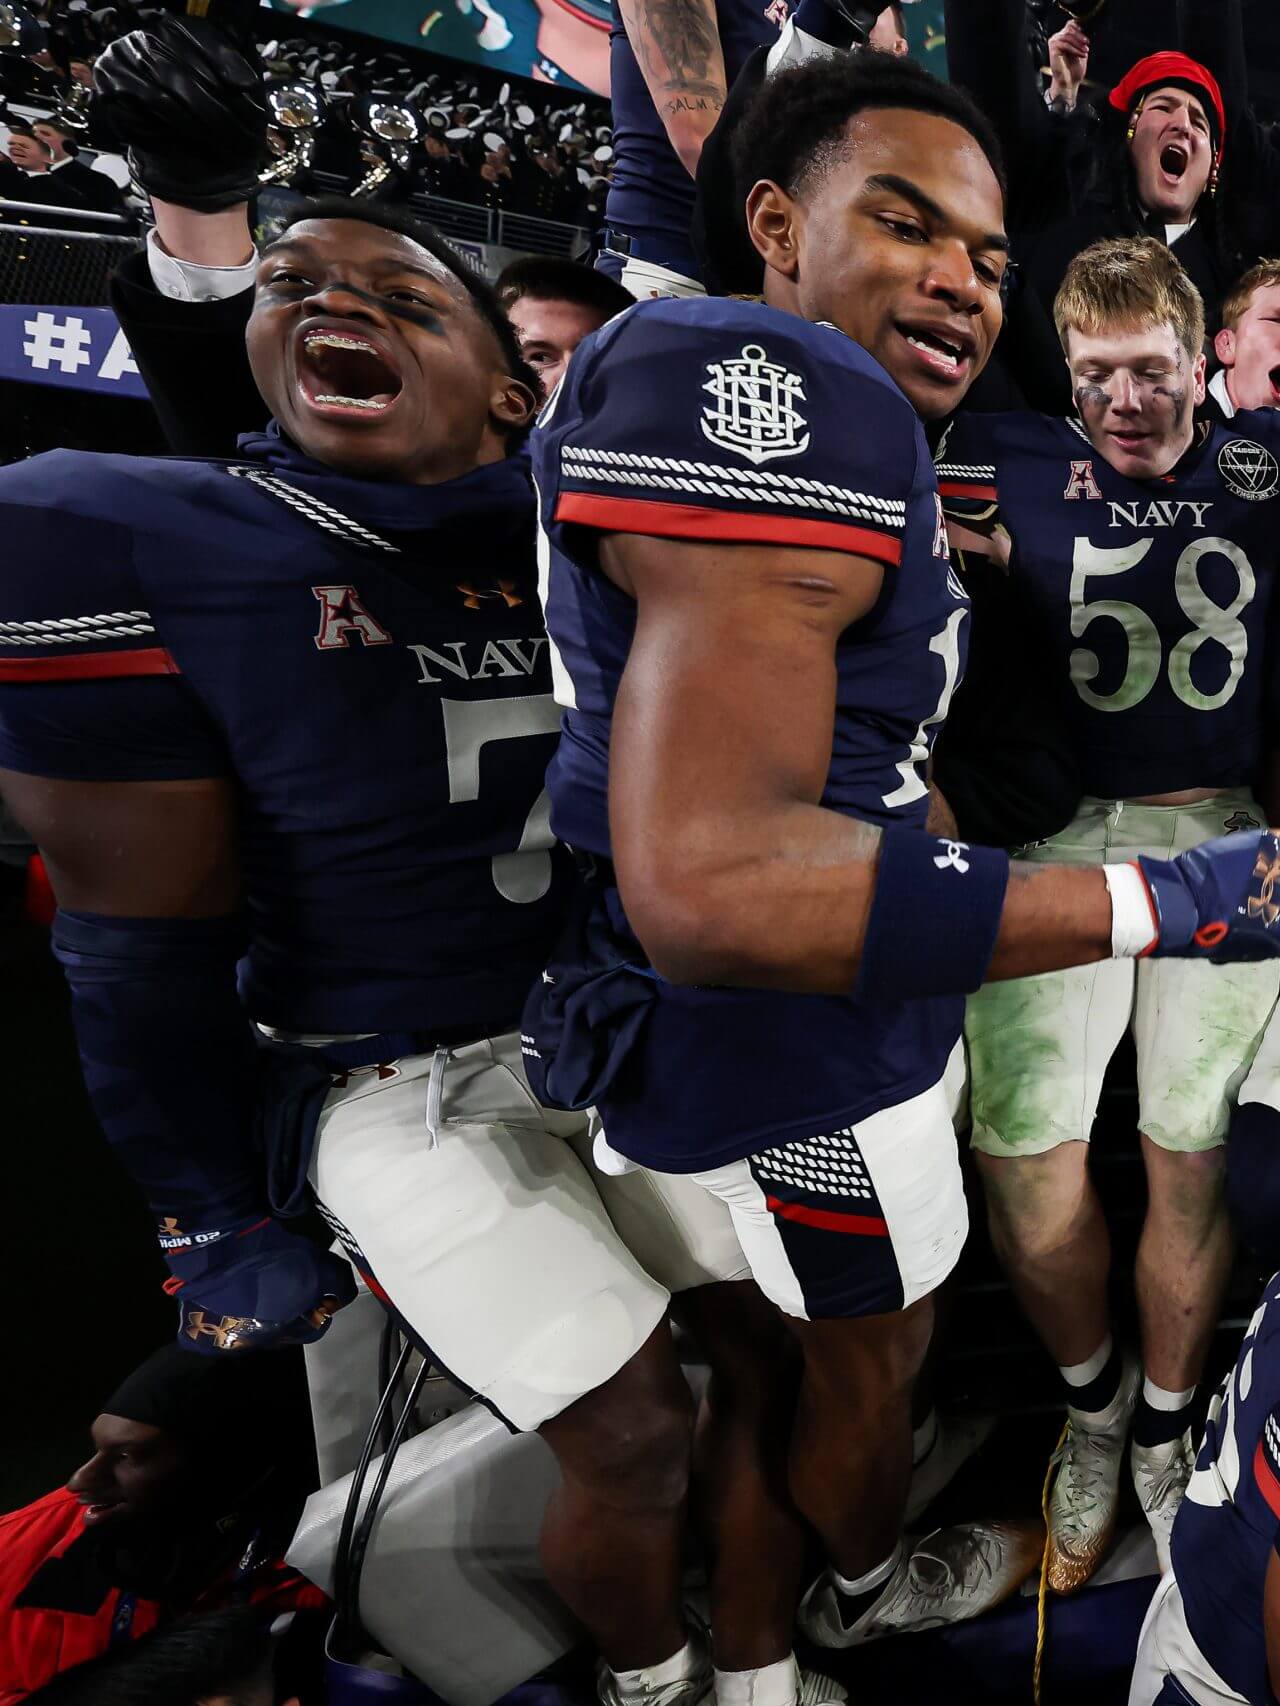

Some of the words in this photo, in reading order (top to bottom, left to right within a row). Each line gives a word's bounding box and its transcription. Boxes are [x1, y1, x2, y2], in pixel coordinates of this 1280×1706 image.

[1106, 501, 1214, 528] NAVY
[1069, 536, 1256, 712] 58
[406, 638, 550, 684] NAV
[440, 694, 560, 904] 7
[160, 1236, 192, 1249] MPH
[195, 1231, 220, 1244] 20
